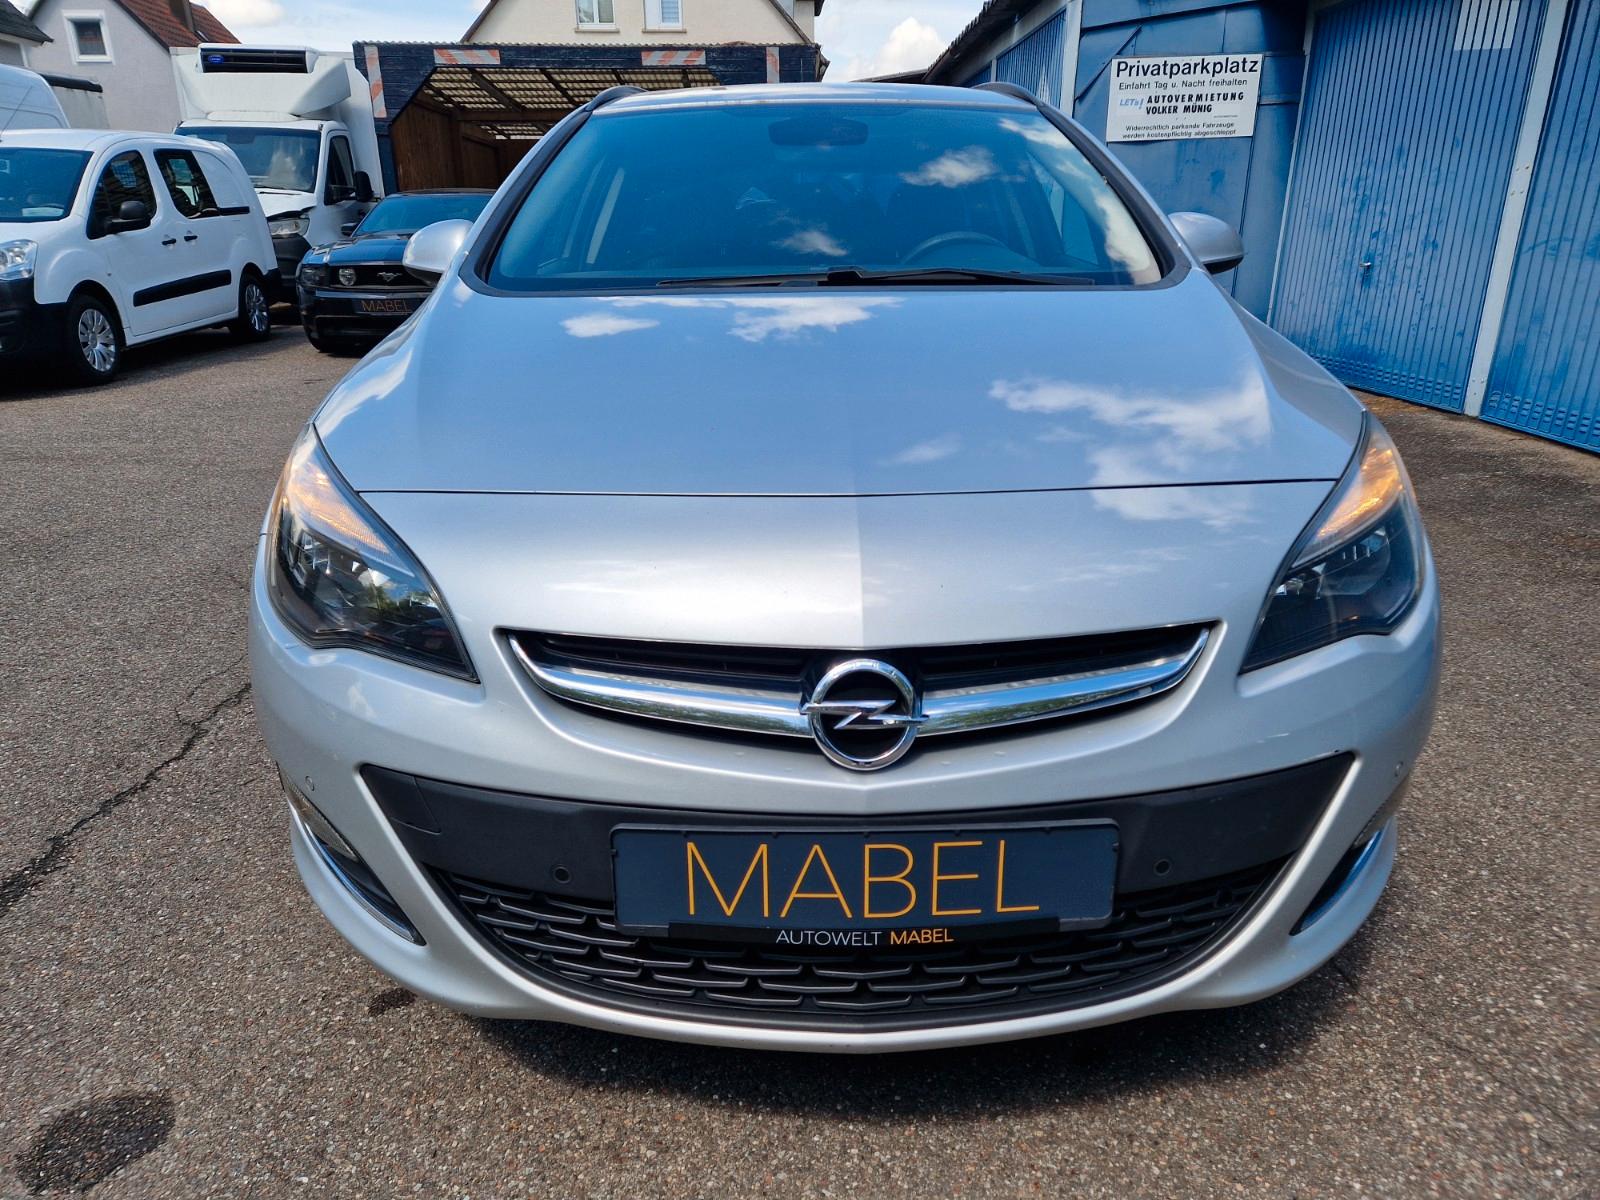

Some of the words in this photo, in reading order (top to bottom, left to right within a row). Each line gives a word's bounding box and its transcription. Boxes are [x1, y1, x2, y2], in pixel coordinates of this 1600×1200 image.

[1116, 57, 1258, 79] Privatparkplatz
[1119, 82, 1150, 91] Einfahrt
[1155, 80, 1168, 90] Tag
[1181, 80, 1205, 88] Nacht
[1209, 78, 1248, 87] freihalten
[1147, 92, 1244, 104] AUTOVERMIETUNG
[1146, 105, 1178, 115] VOLKER
[1183, 103, 1213, 114] MÜNIG
[686, 840, 1040, 920] MABEL
[776, 929, 882, 947] AUTOWELT
[889, 929, 954, 946] MABEL
